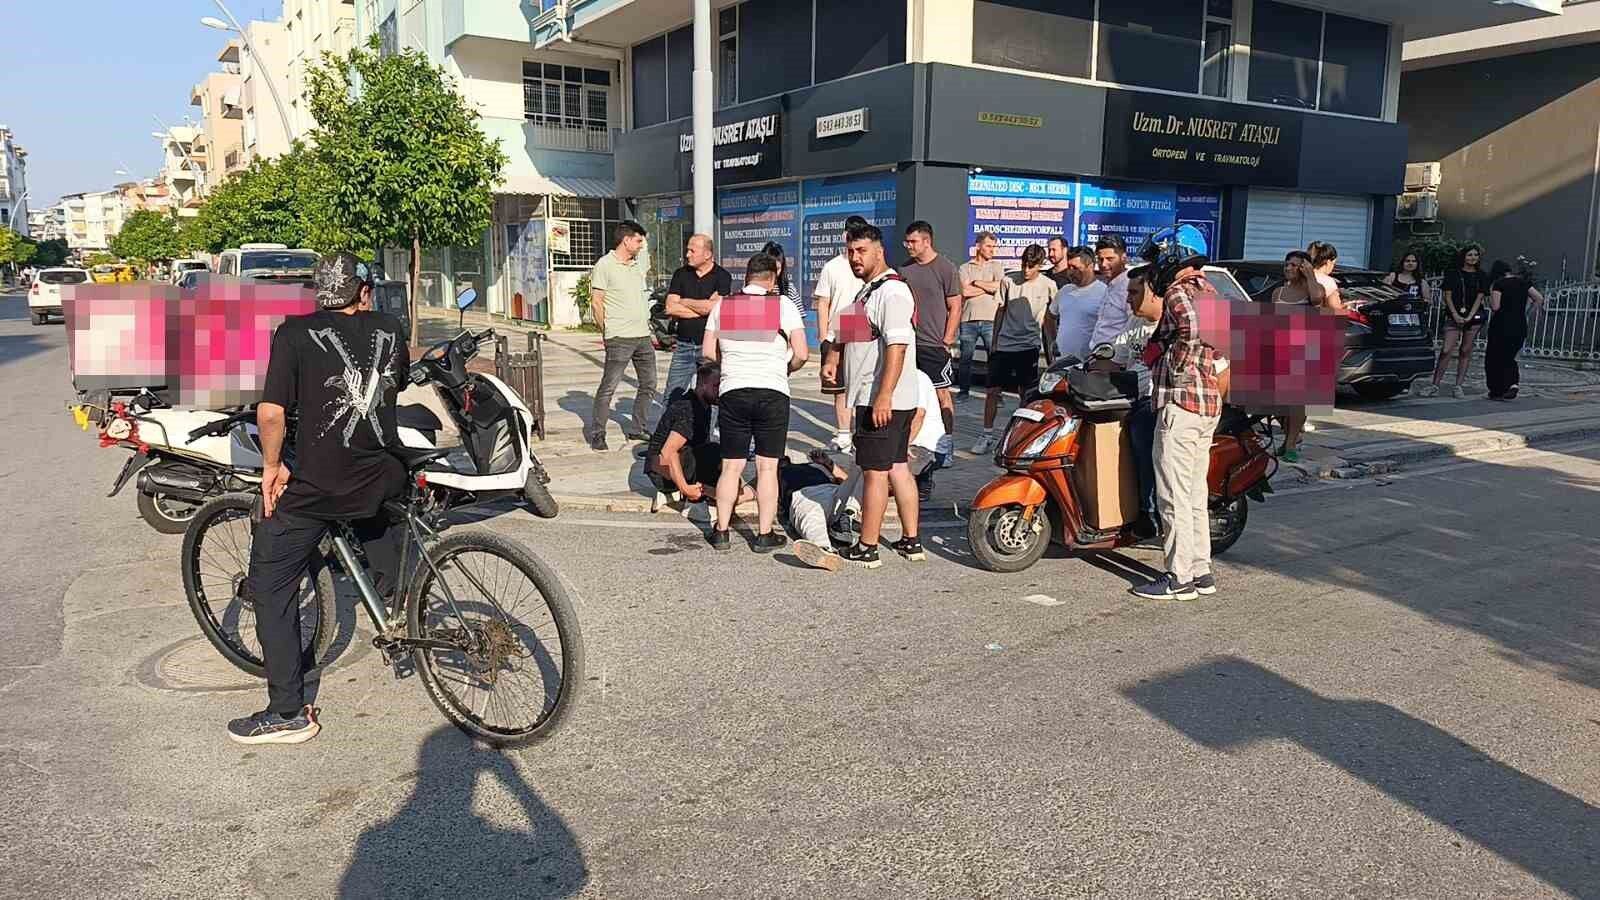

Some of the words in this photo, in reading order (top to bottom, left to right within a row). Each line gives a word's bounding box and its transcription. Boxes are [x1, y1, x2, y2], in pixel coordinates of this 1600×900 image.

[745, 114, 775, 144] ATAŞLI
[1239, 123, 1280, 148] ATAŞLI
[1152, 147, 1188, 160] ORTOPEDİ
[1195, 152, 1206, 161] VE
